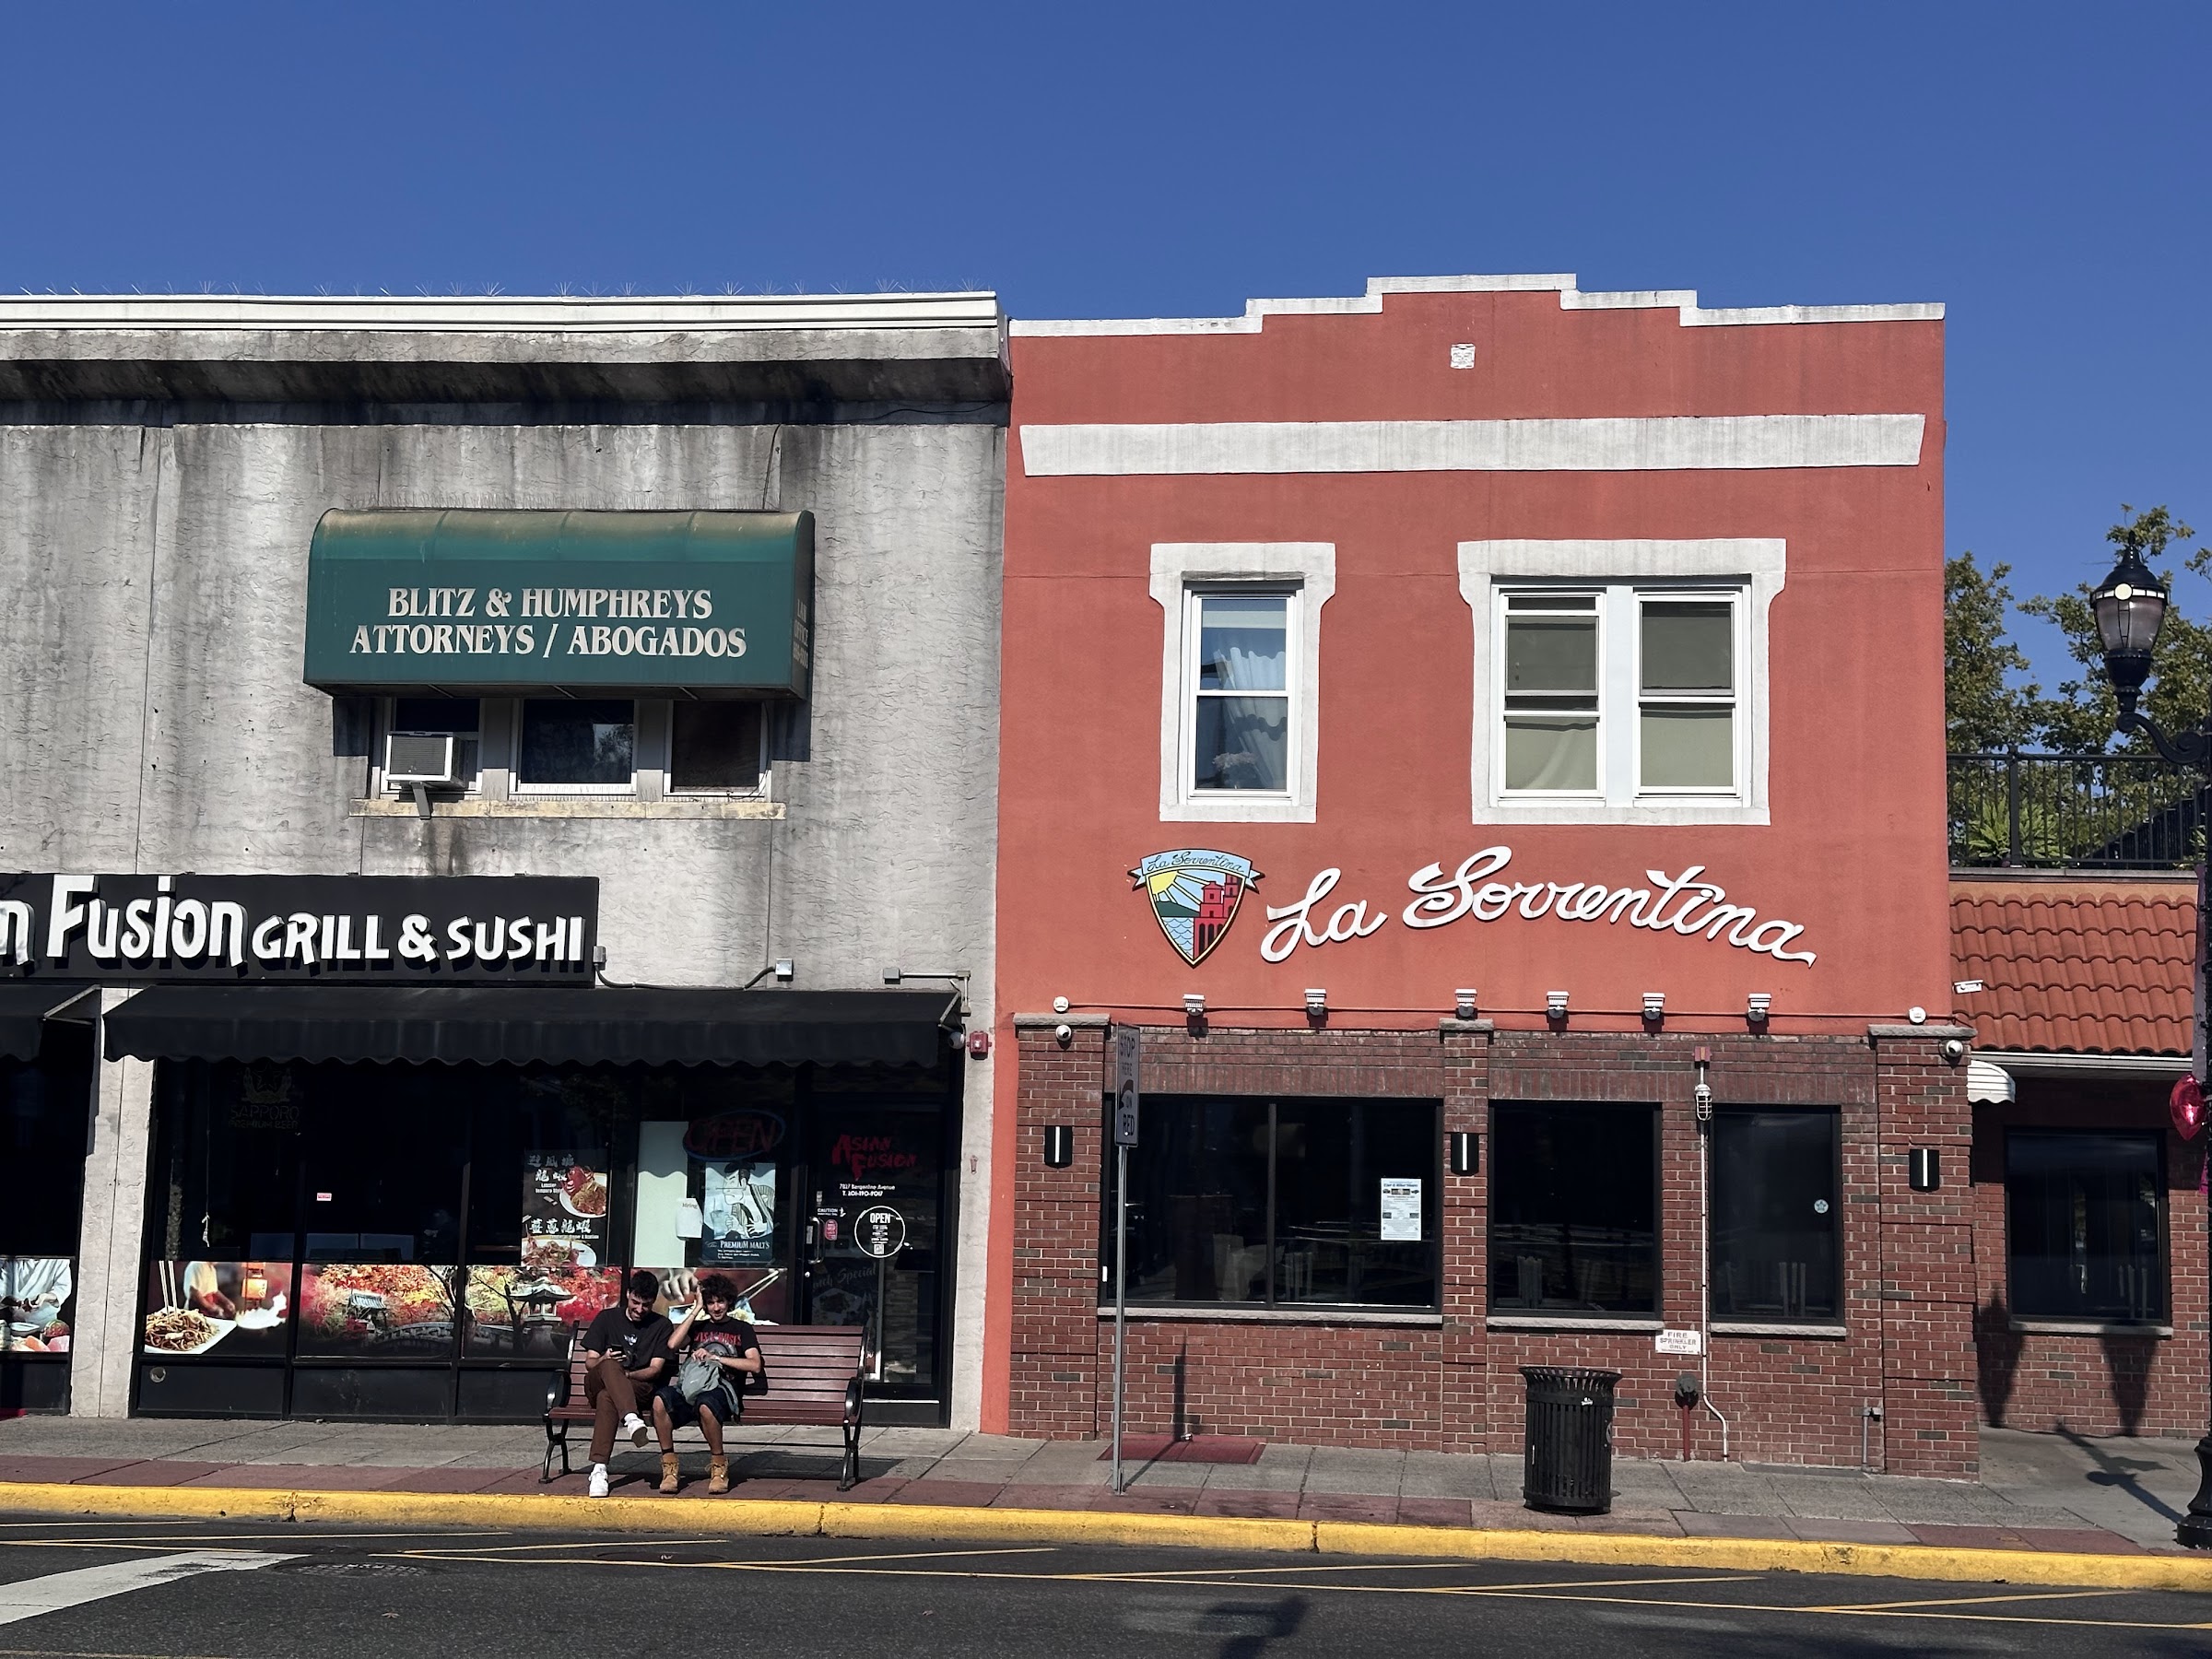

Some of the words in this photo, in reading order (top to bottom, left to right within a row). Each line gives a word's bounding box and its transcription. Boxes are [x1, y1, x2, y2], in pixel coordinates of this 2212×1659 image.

[387, 587, 477, 617] BLITZ
[486, 588, 512, 618] &
[520, 588, 712, 619] HUMPHREYS
[349, 623, 535, 654] ATTORNEYS
[542, 623, 559, 659] /
[566, 627, 747, 658] ABOGADOS
[1147, 854, 1170, 872] La
[1171, 851, 1244, 873] Sorrentina
[1260, 867, 1389, 964] La
[1402, 845, 1818, 969] Sorrentina
[46, 874, 247, 965] Fusion
[253, 912, 391, 964] GRILL
[399, 913, 438, 961] &
[446, 915, 584, 962] SUSHI
[1120, 1034, 1135, 1057] STOP
[229, 1104, 300, 1121] SAPPORO
[686, 1117, 778, 1153] OPEN
[1123, 1113, 1135, 1136] RED
[831, 1134, 892, 1166] ASIAN
[851, 1152, 918, 1182] FUSION
[869, 1212, 891, 1224] OPEN
[720, 1241, 748, 1249] PREMIUM
[749, 1241, 771, 1250] MALT'S
[837, 1262, 877, 1285] Special
[1660, 1337, 1697, 1346] SPRINKLER
